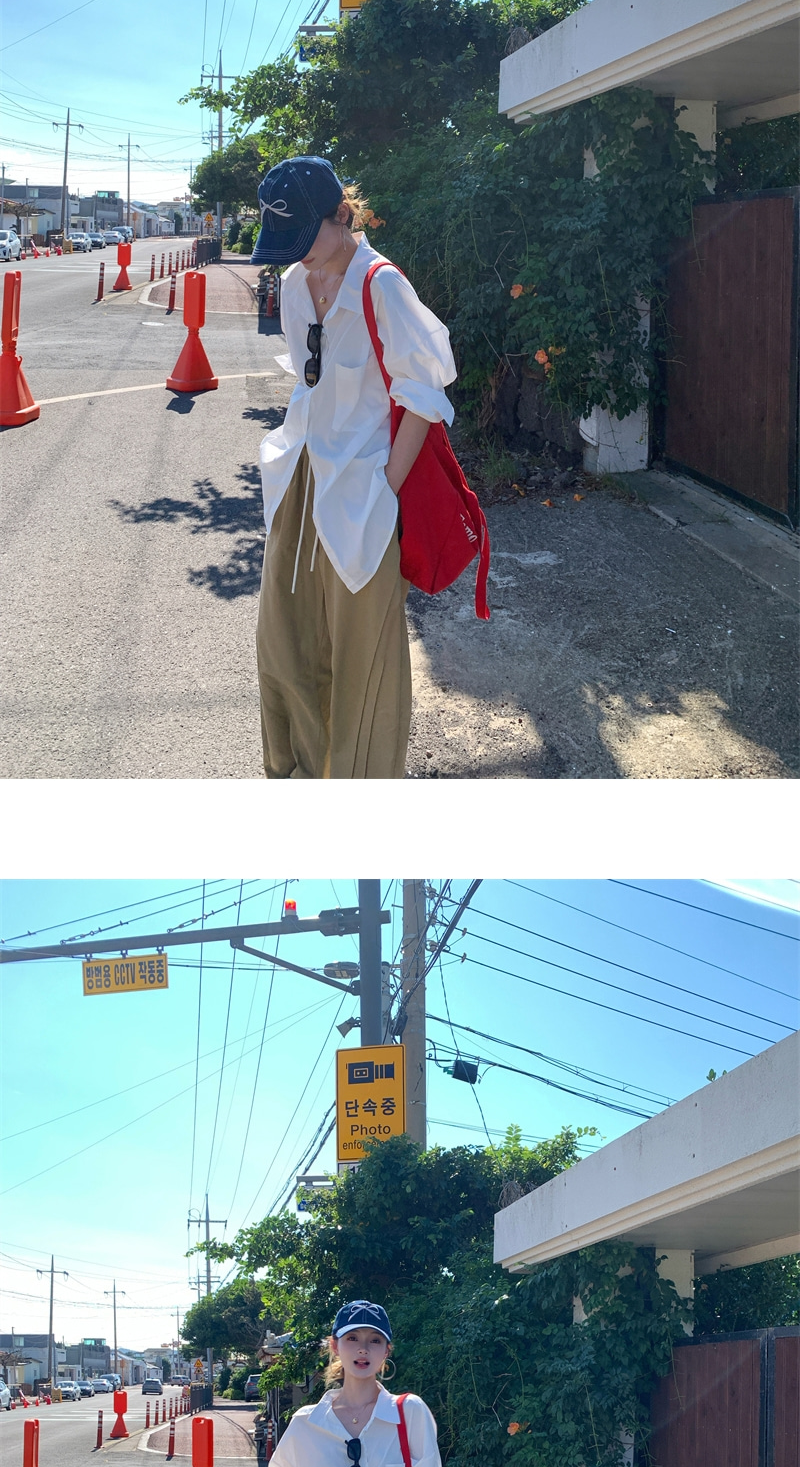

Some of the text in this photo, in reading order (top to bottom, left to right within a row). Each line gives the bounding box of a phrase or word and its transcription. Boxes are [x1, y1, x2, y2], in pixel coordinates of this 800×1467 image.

[86, 959, 165, 990] 방범용 CCTV 작동중
[345, 1097, 396, 1118] 단속중
[350, 1124, 391, 1136] Photo
